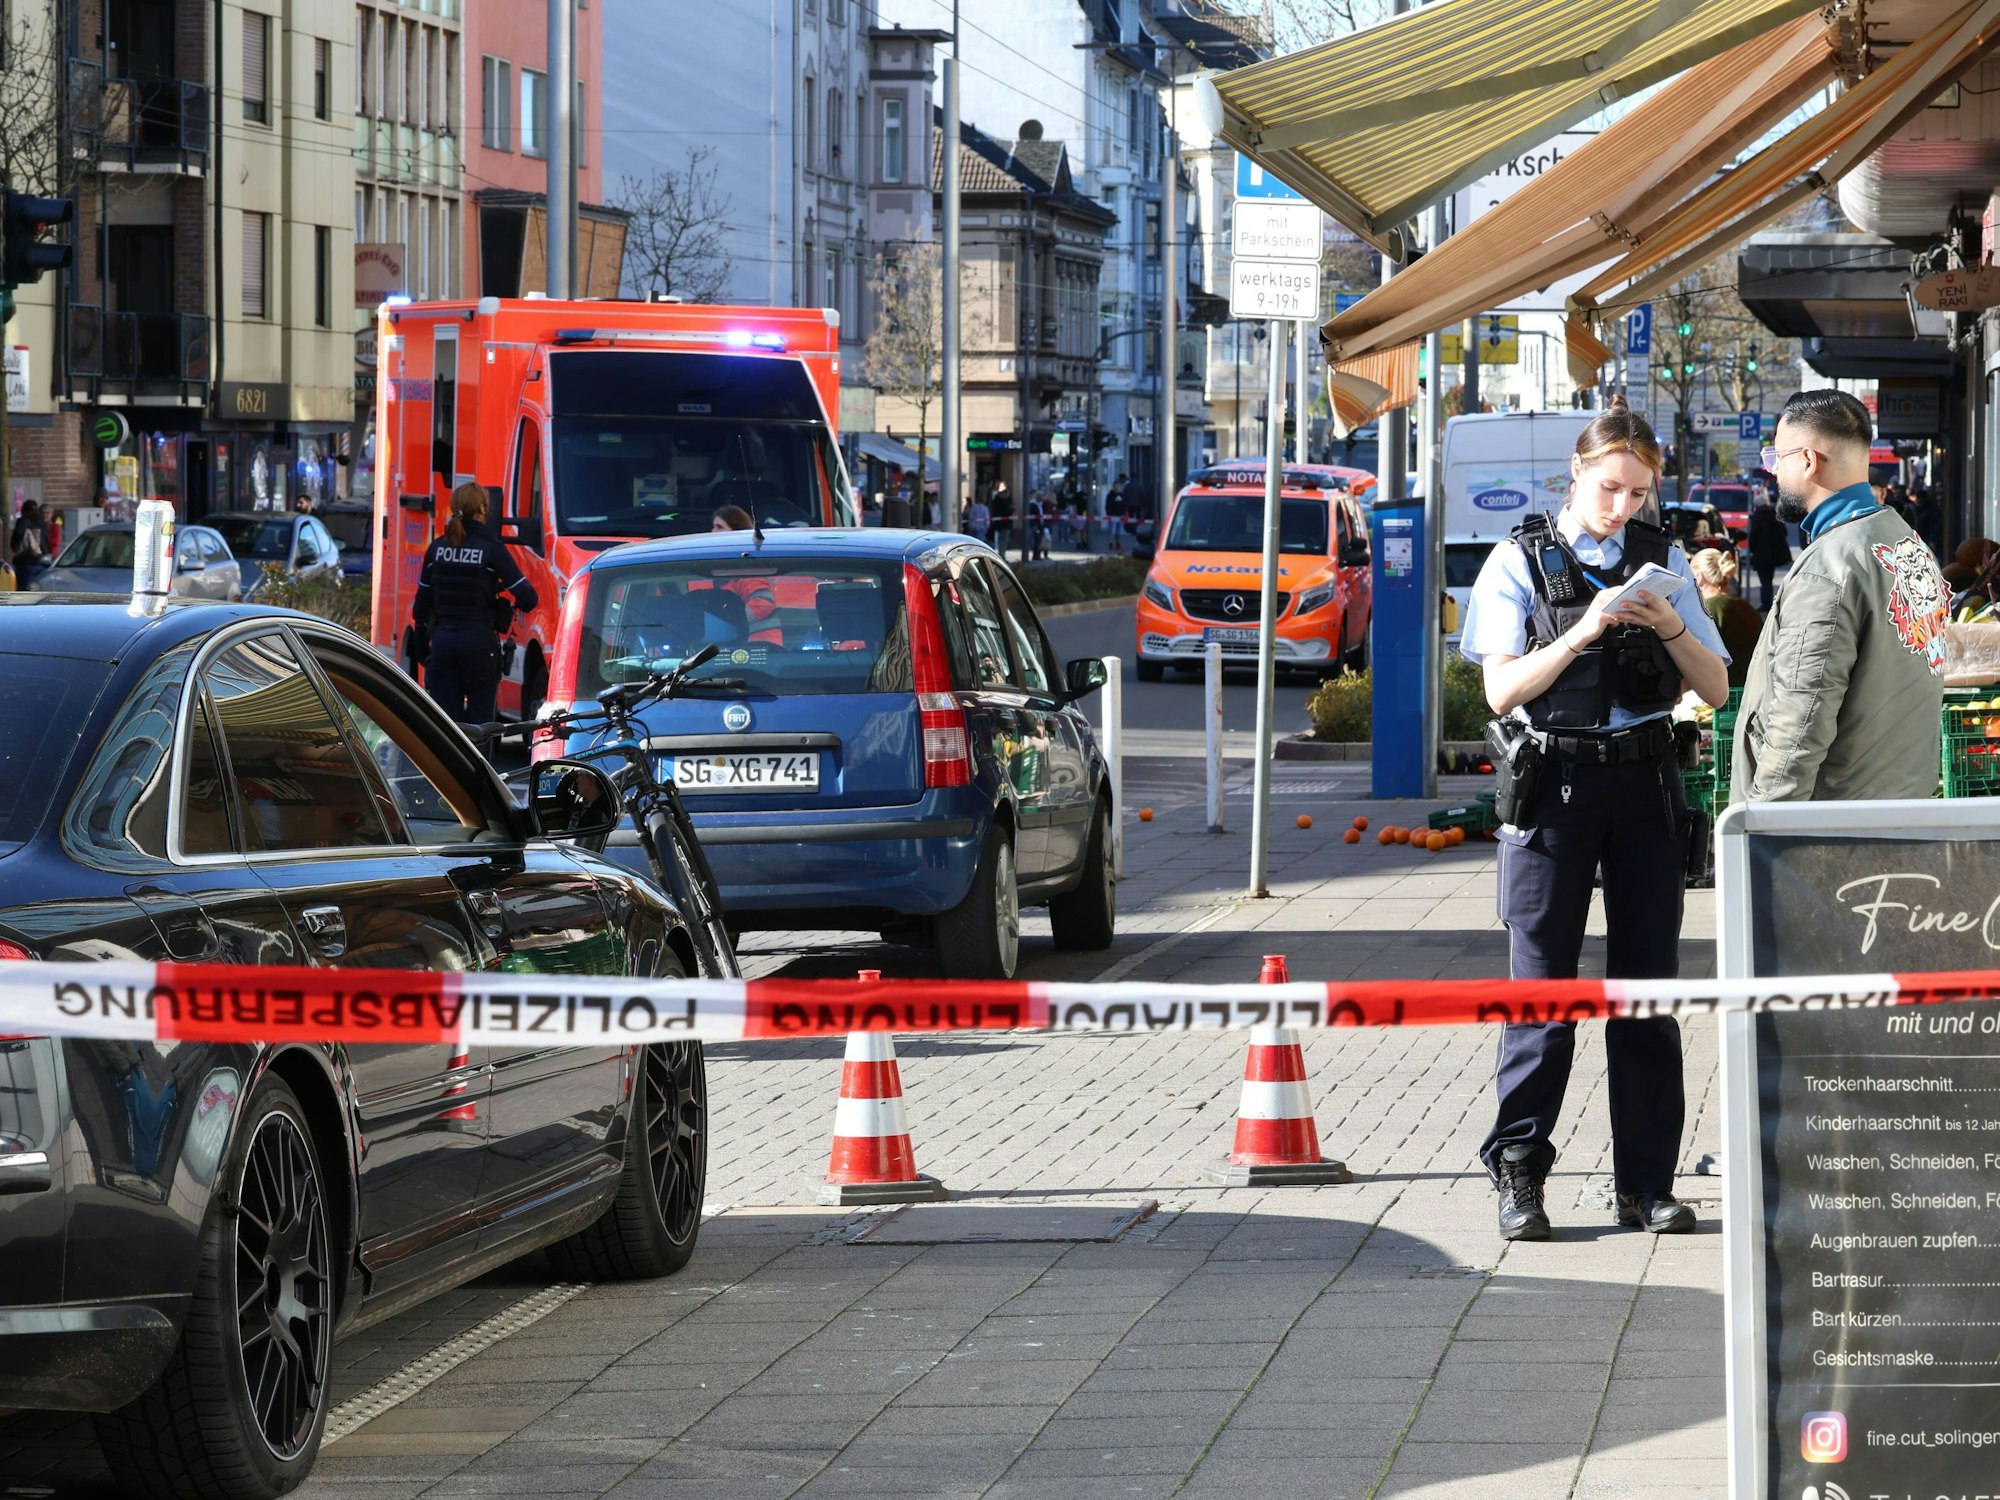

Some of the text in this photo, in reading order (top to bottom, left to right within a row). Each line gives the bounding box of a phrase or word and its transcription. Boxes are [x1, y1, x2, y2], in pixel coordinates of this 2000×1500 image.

[1267, 217, 1288, 229] mit
[1240, 231, 1314, 248] Parkschein
[1239, 272, 1312, 292] werktags
[1630, 308, 1645, 348] P
[236, 388, 266, 413] 6821
[1742, 415, 1755, 436] P
[1227, 471, 1291, 484] NOTAT
[1480, 494, 1521, 507] confeti
[435, 547, 484, 564] POLIZEI
[1186, 565, 1290, 577] Notart
[728, 713, 747, 723] FIAT
[678, 756, 815, 784] SG XG 741
[1835, 873, 1981, 955] Fine
[1886, 1012, 1924, 1034] mit
[1929, 1012, 1975, 1034] und
[1805, 1114, 1942, 1131] Kinderhaarschnit
[1945, 1118, 1962, 1131] bis
[1966, 1119, 1979, 1131] 12
[1807, 1154, 1886, 1172] Waschen,
[1889, 1153, 1981, 1172] Schneiden,
[1808, 1193, 1887, 1211] Waschen,
[1891, 1192, 1982, 1211] Schneiden,
[1810, 1232, 1919, 1252] Augenbrauen
[1811, 1310, 1846, 1327] Bart
[1866, 1429, 2000, 1449] fine.cut_solingen
